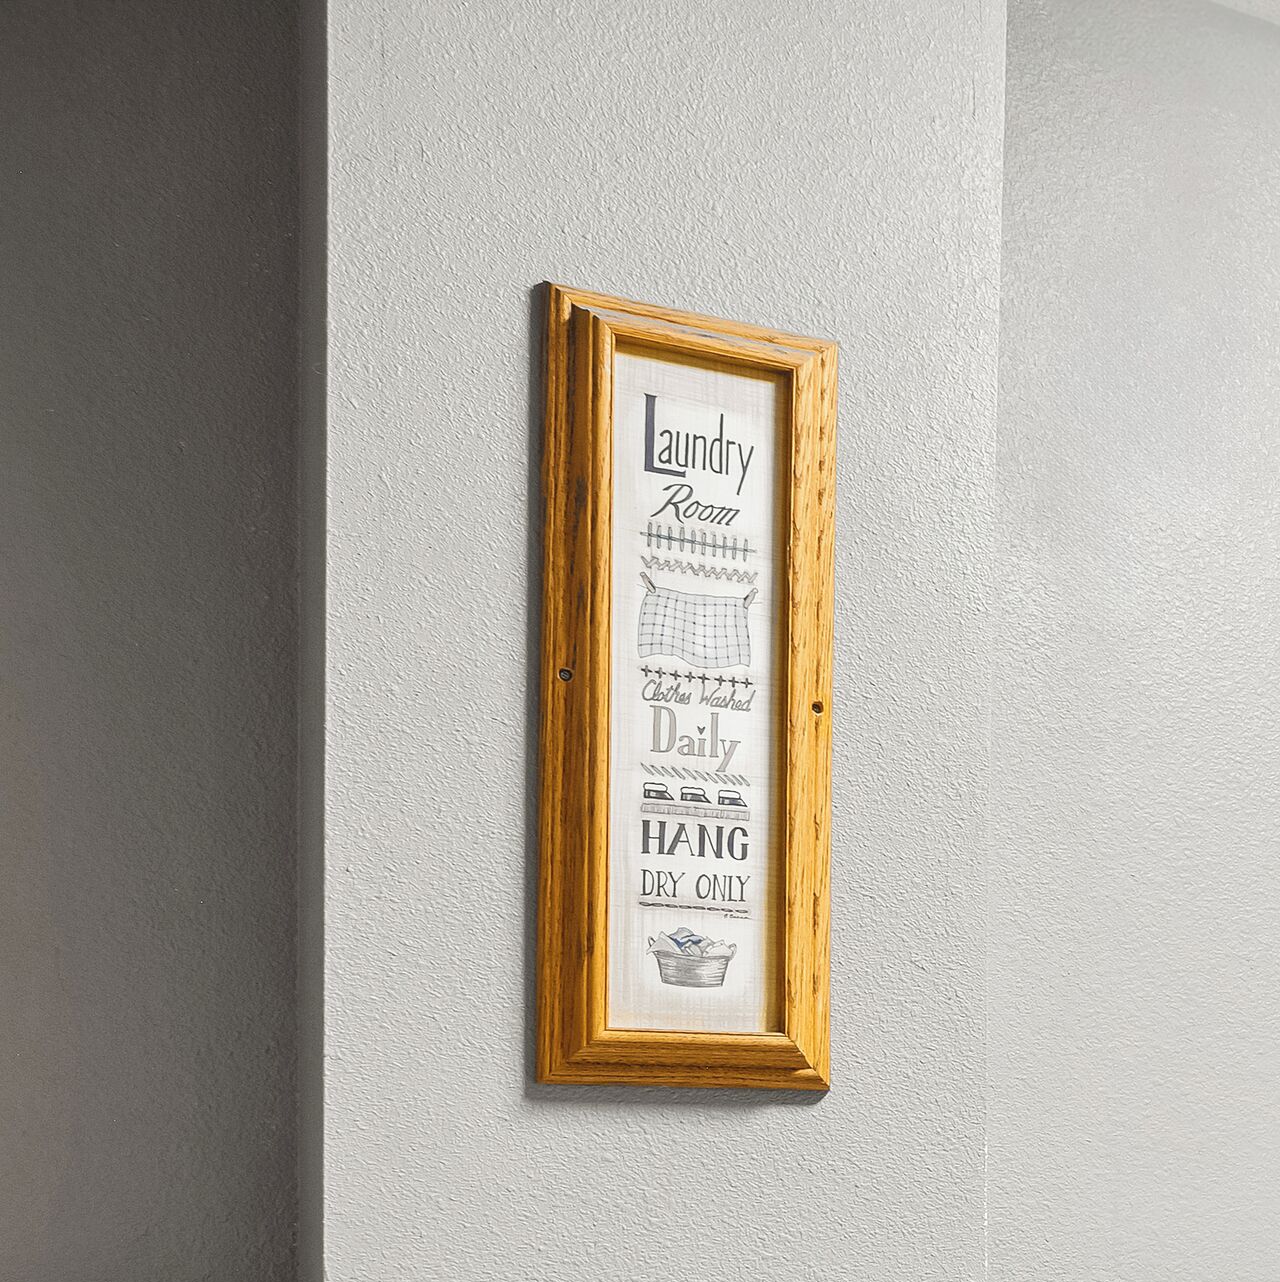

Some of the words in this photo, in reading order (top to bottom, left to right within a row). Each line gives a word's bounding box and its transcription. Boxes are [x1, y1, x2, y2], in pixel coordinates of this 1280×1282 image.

[644, 393, 754, 495] Laundry
[651, 484, 740, 526] Room
[641, 679, 692, 705] Clothes
[699, 682, 756, 711] Washed
[650, 705, 741, 772] Daily
[641, 819, 749, 861] HANG
[641, 869, 686, 899] DRY
[696, 874, 751, 902] ONLY
